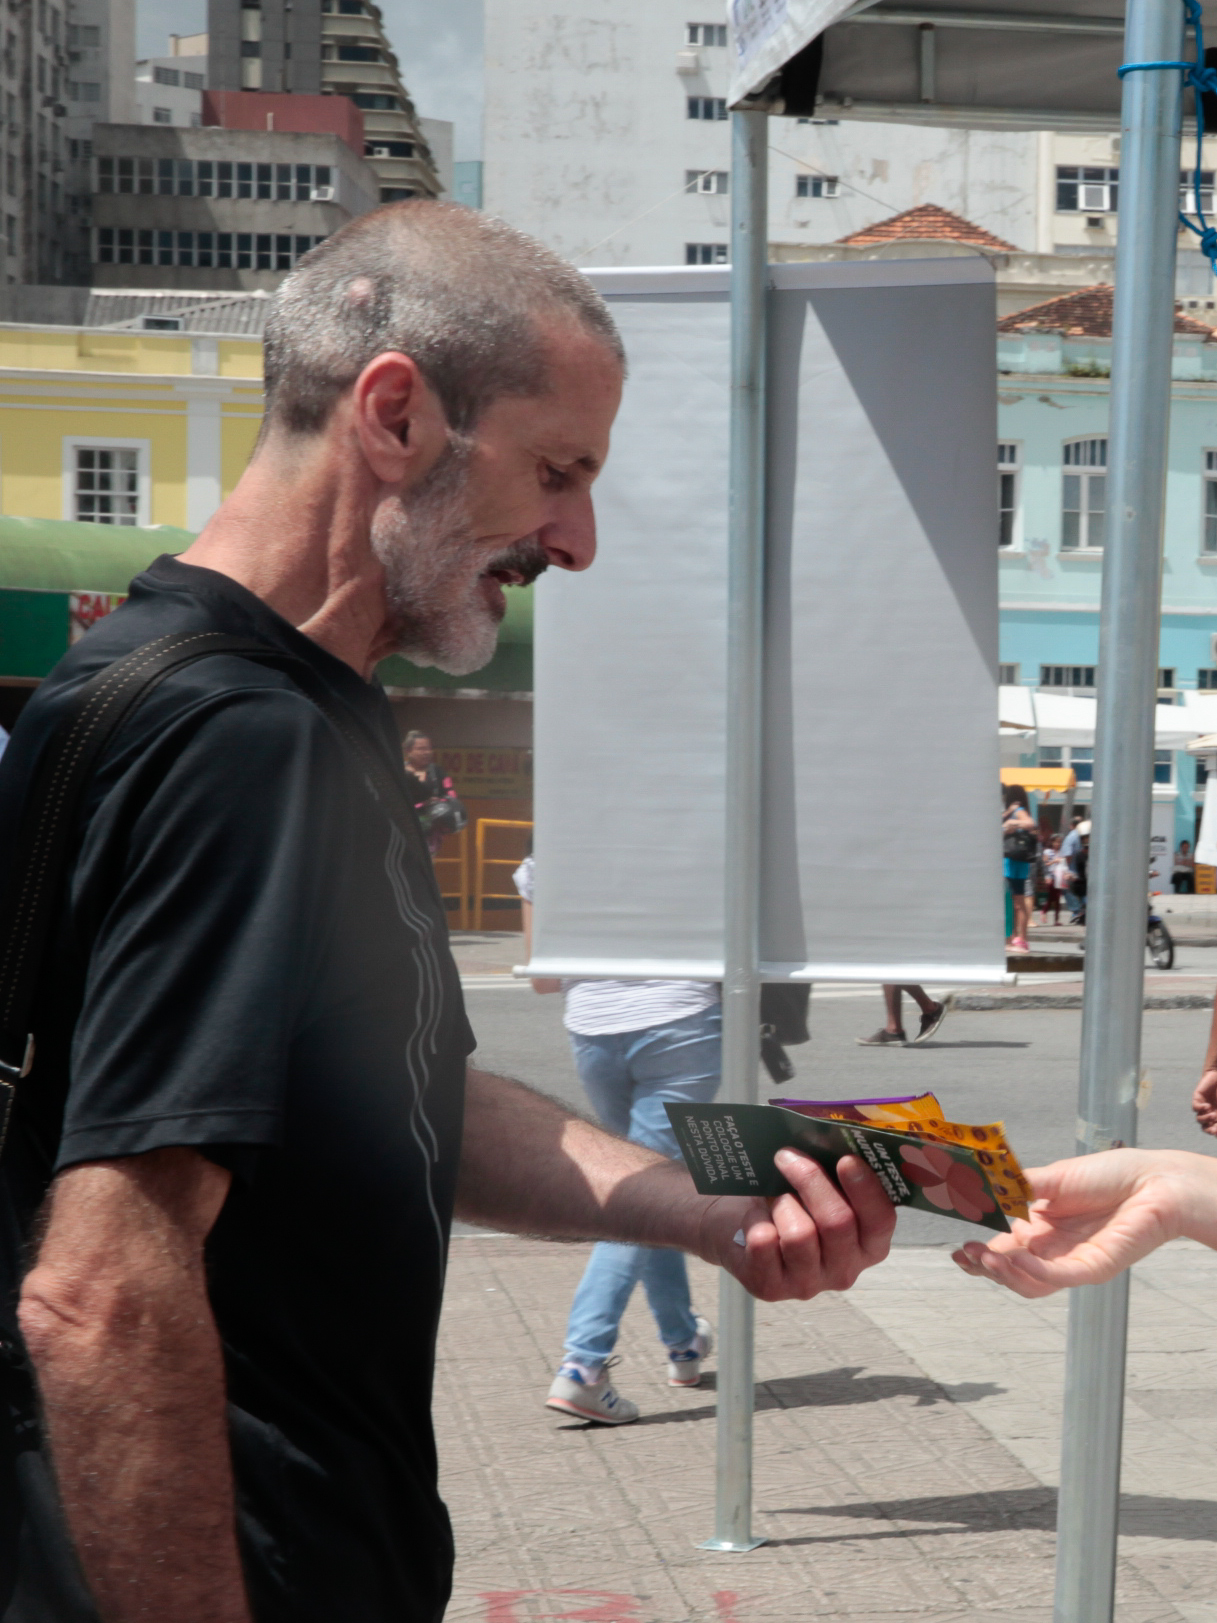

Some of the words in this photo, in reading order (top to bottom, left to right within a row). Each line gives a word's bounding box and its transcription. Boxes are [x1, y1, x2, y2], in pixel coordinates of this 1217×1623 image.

[685, 1115, 704, 1146] NESTA
[724, 1115, 740, 1139] FAÇA
[700, 1120, 720, 1152] PONTO
[713, 1153, 730, 1180] FINAL
[713, 1120, 737, 1164] COLOQUE
[731, 1165, 744, 1180] UM
[734, 1141, 744, 1149] O
[851, 1129, 883, 1170] MUITAS
[738, 1150, 756, 1178] TESTE
[873, 1142, 891, 1160] UM
[884, 1161, 911, 1197] TESTE
[749, 1179, 759, 1187] E
